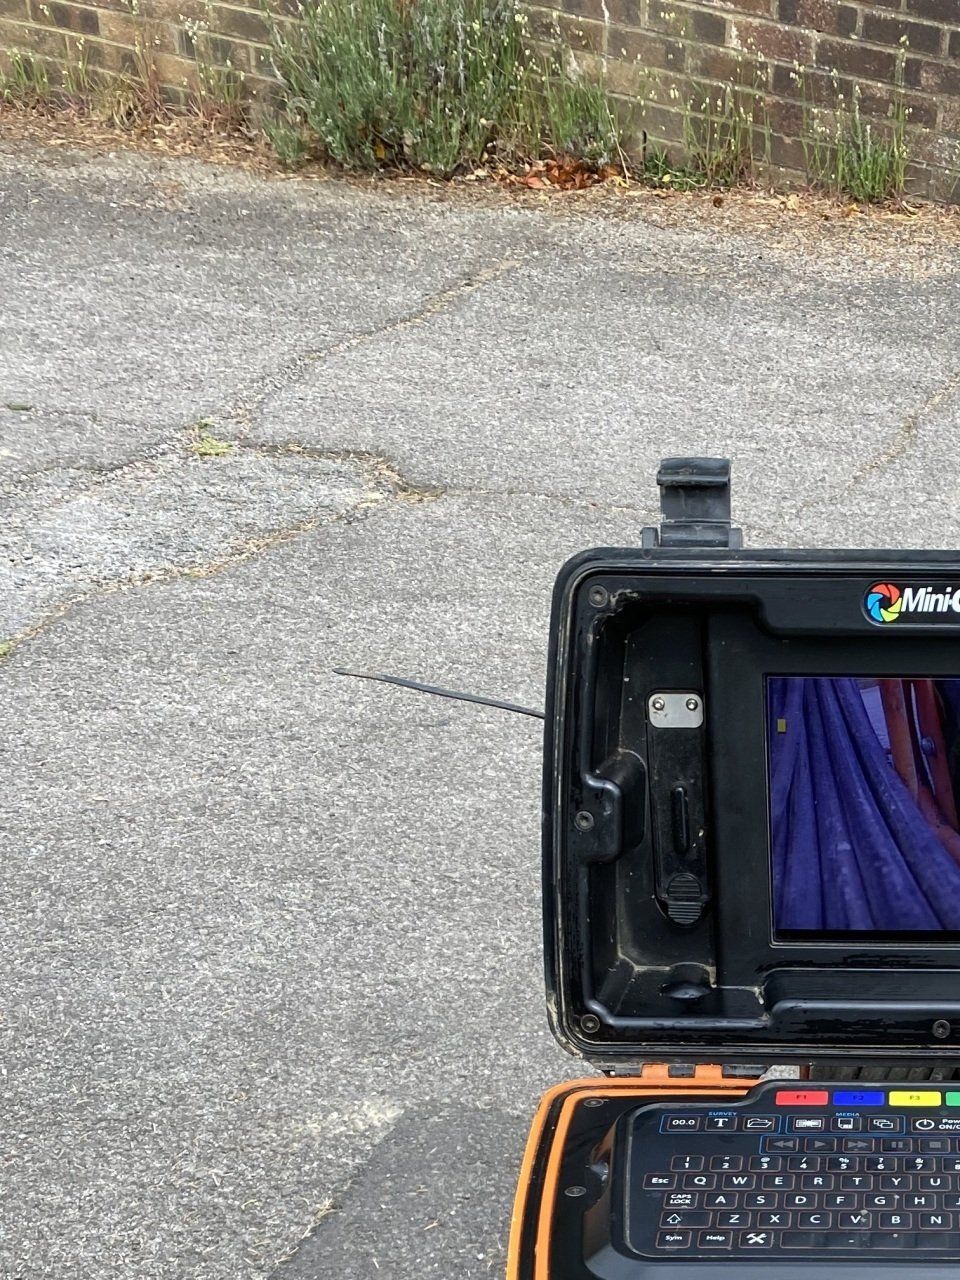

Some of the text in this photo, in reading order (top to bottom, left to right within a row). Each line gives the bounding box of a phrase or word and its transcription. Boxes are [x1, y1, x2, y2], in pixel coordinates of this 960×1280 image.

[694, 1176, 706, 1185] Q
[732, 1176, 748, 1184] W
[814, 1177, 822, 1185] R
[892, 1178, 902, 1186] Y
[714, 1196, 726, 1204] A
[756, 1196, 766, 1204] S
[794, 1196, 807, 1204] D
[836, 1196, 845, 1204] F
[874, 1196, 886, 1204] G
[914, 1196, 925, 1204] H
[728, 1214, 740, 1222] Z
[770, 1214, 780, 1223] X
[810, 1215, 821, 1223] C
[850, 1216, 861, 1224] V
